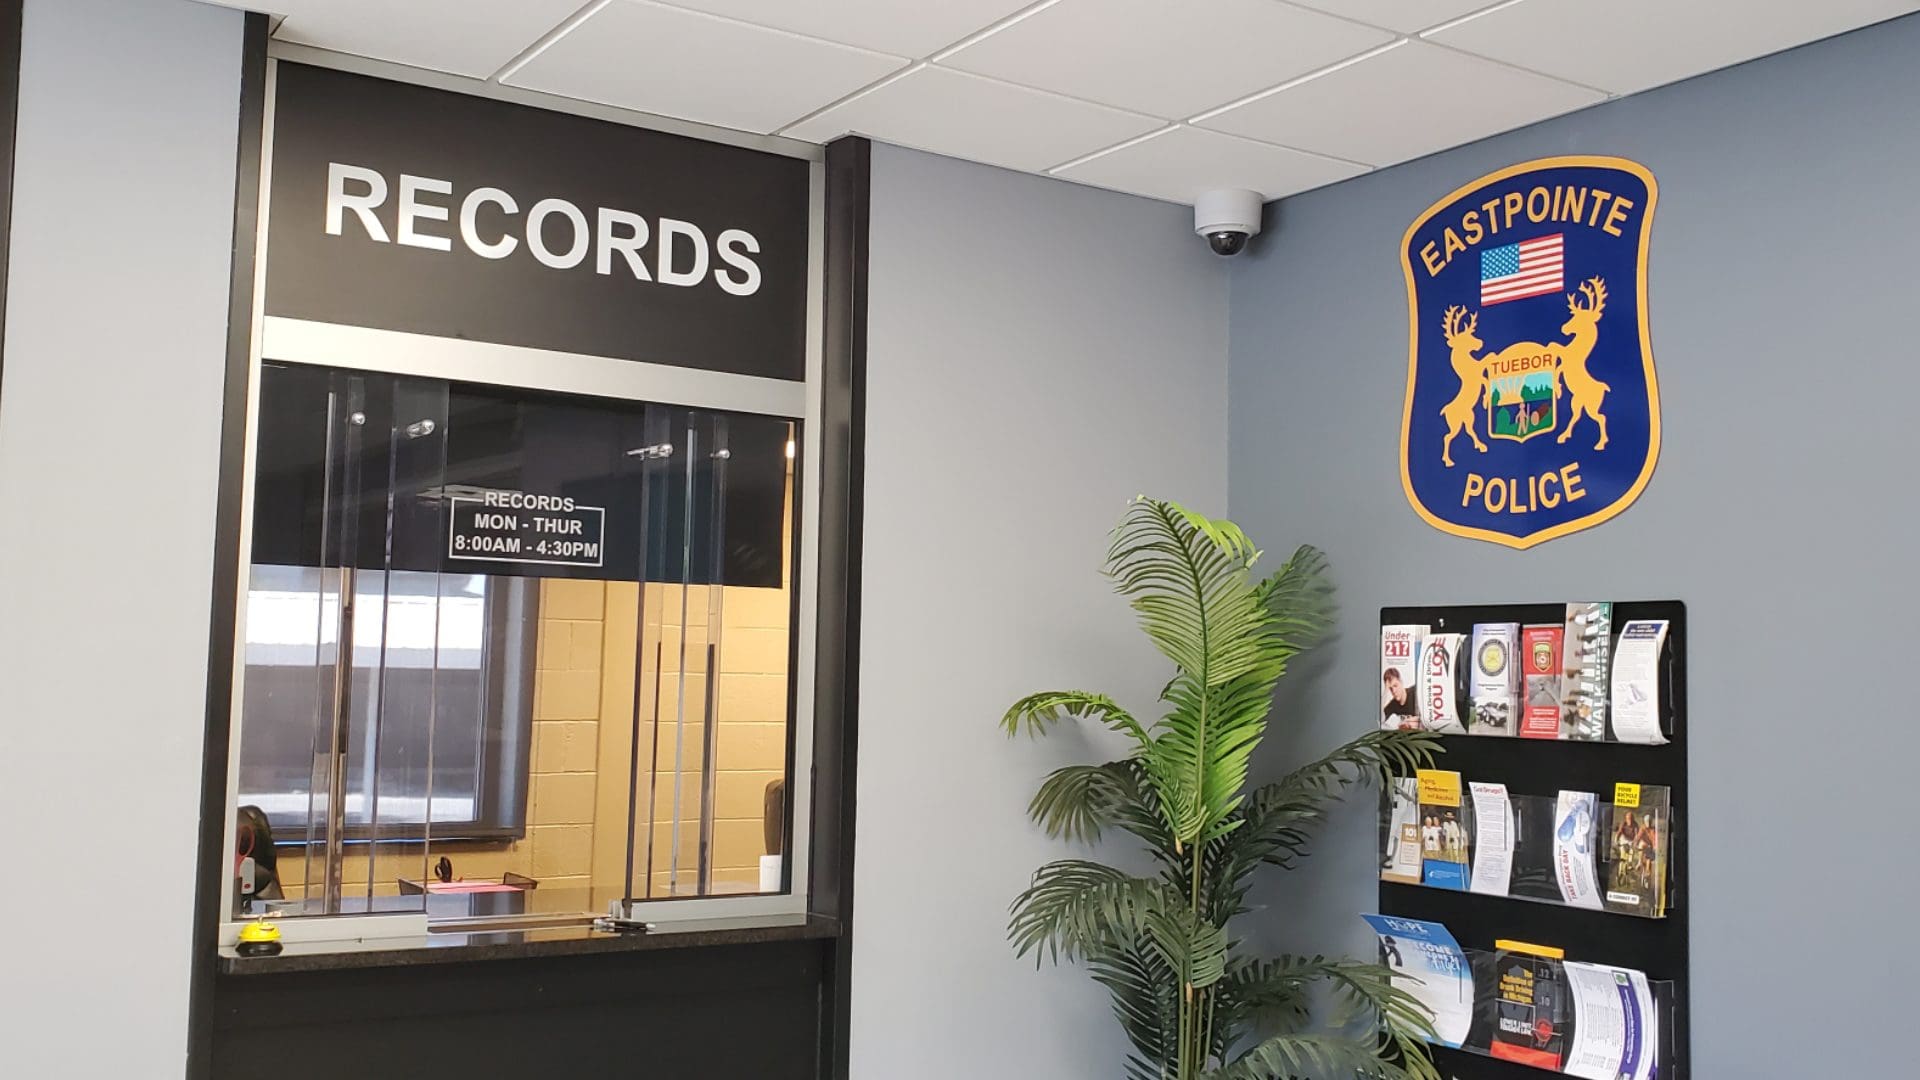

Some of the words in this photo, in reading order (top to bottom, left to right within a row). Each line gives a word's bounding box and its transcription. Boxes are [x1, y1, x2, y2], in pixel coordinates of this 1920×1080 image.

[325, 162, 762, 297] RECORDS
[1419, 185, 1634, 278] EASTPOINTE
[1491, 353, 1553, 374] TUEBOR
[1462, 462, 1586, 514] POLICE
[484, 491, 575, 512] RECORDS
[474, 513, 517, 531] MON
[533, 517, 582, 535] THUR
[455, 535, 521, 553] 8:00AM
[536, 539, 598, 558] 4:30PM
[1385, 630, 1410, 640] Under
[1432, 685, 1443, 721] YOU
